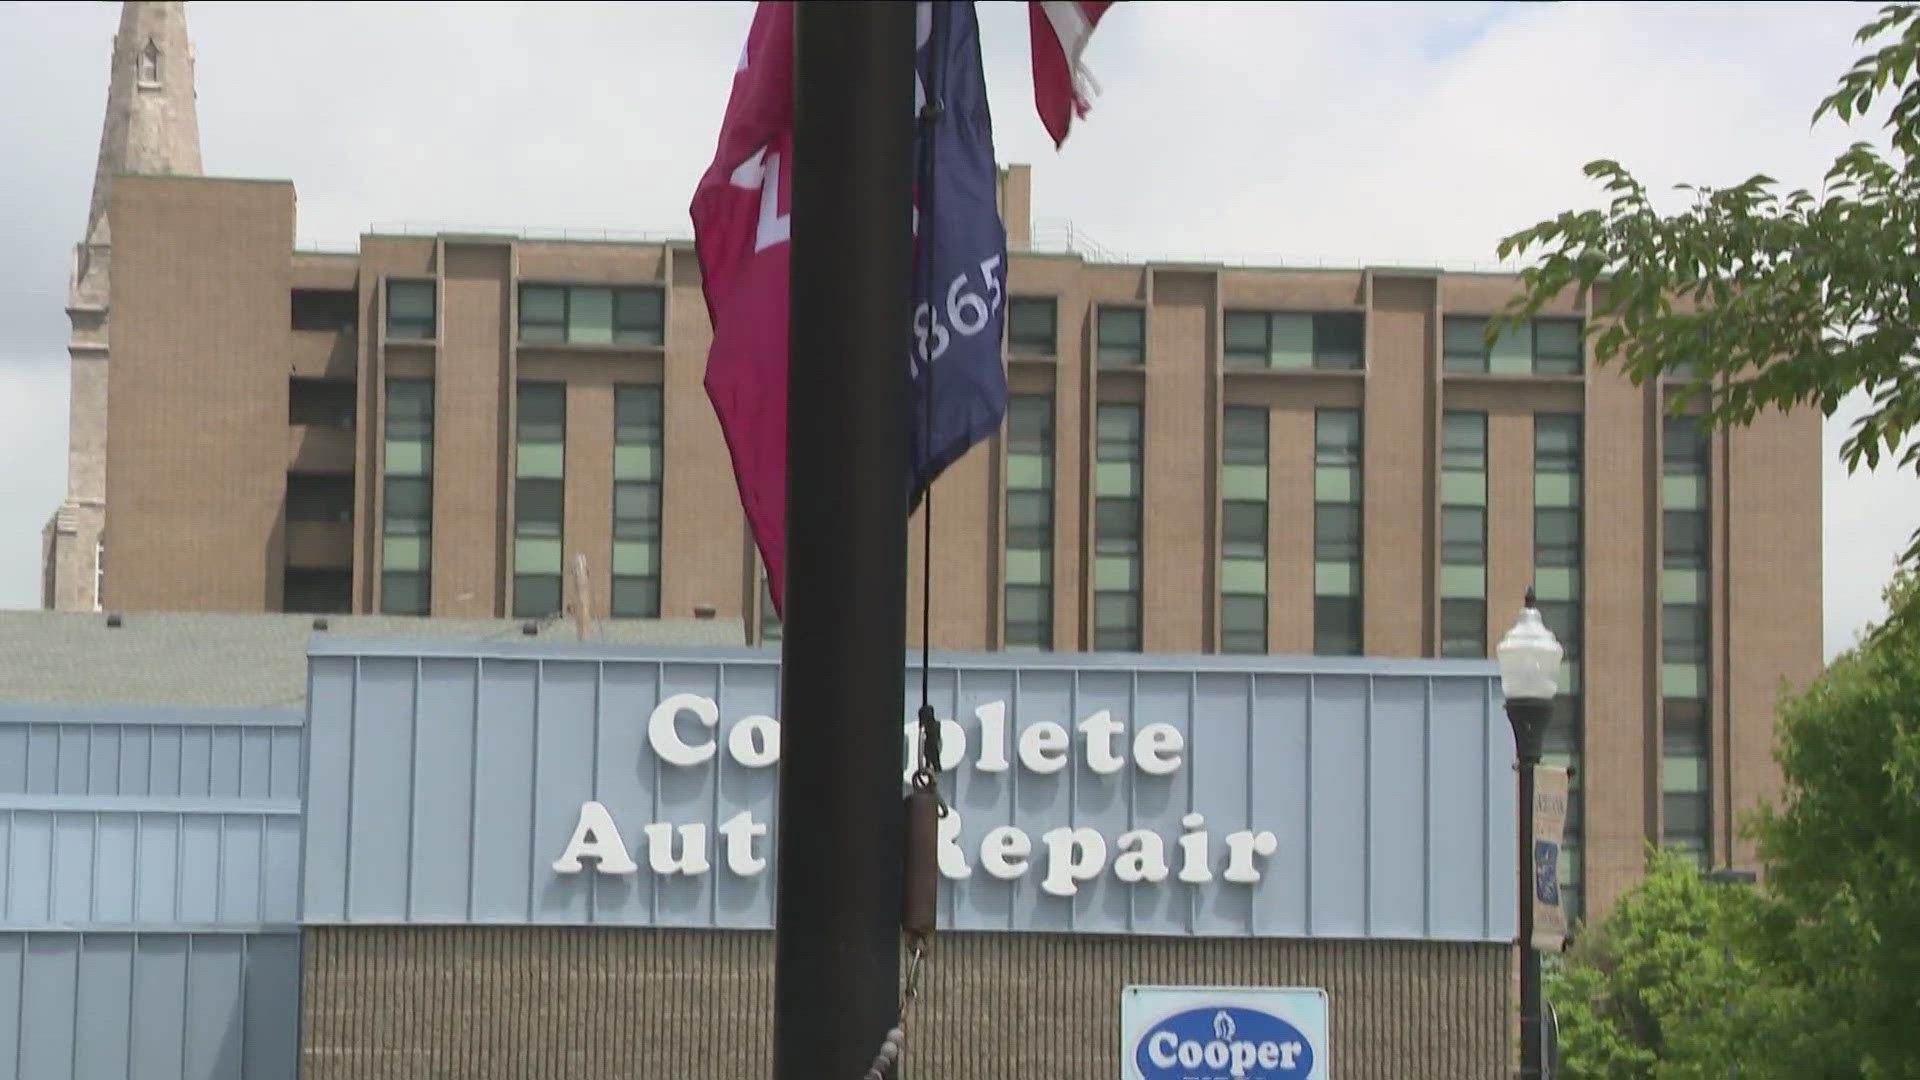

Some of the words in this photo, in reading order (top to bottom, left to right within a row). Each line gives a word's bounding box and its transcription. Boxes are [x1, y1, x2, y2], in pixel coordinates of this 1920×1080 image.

[648, 692, 1184, 786] Coplete
[552, 800, 767, 876] Aut
[1148, 1030, 1302, 1077] Cooper
